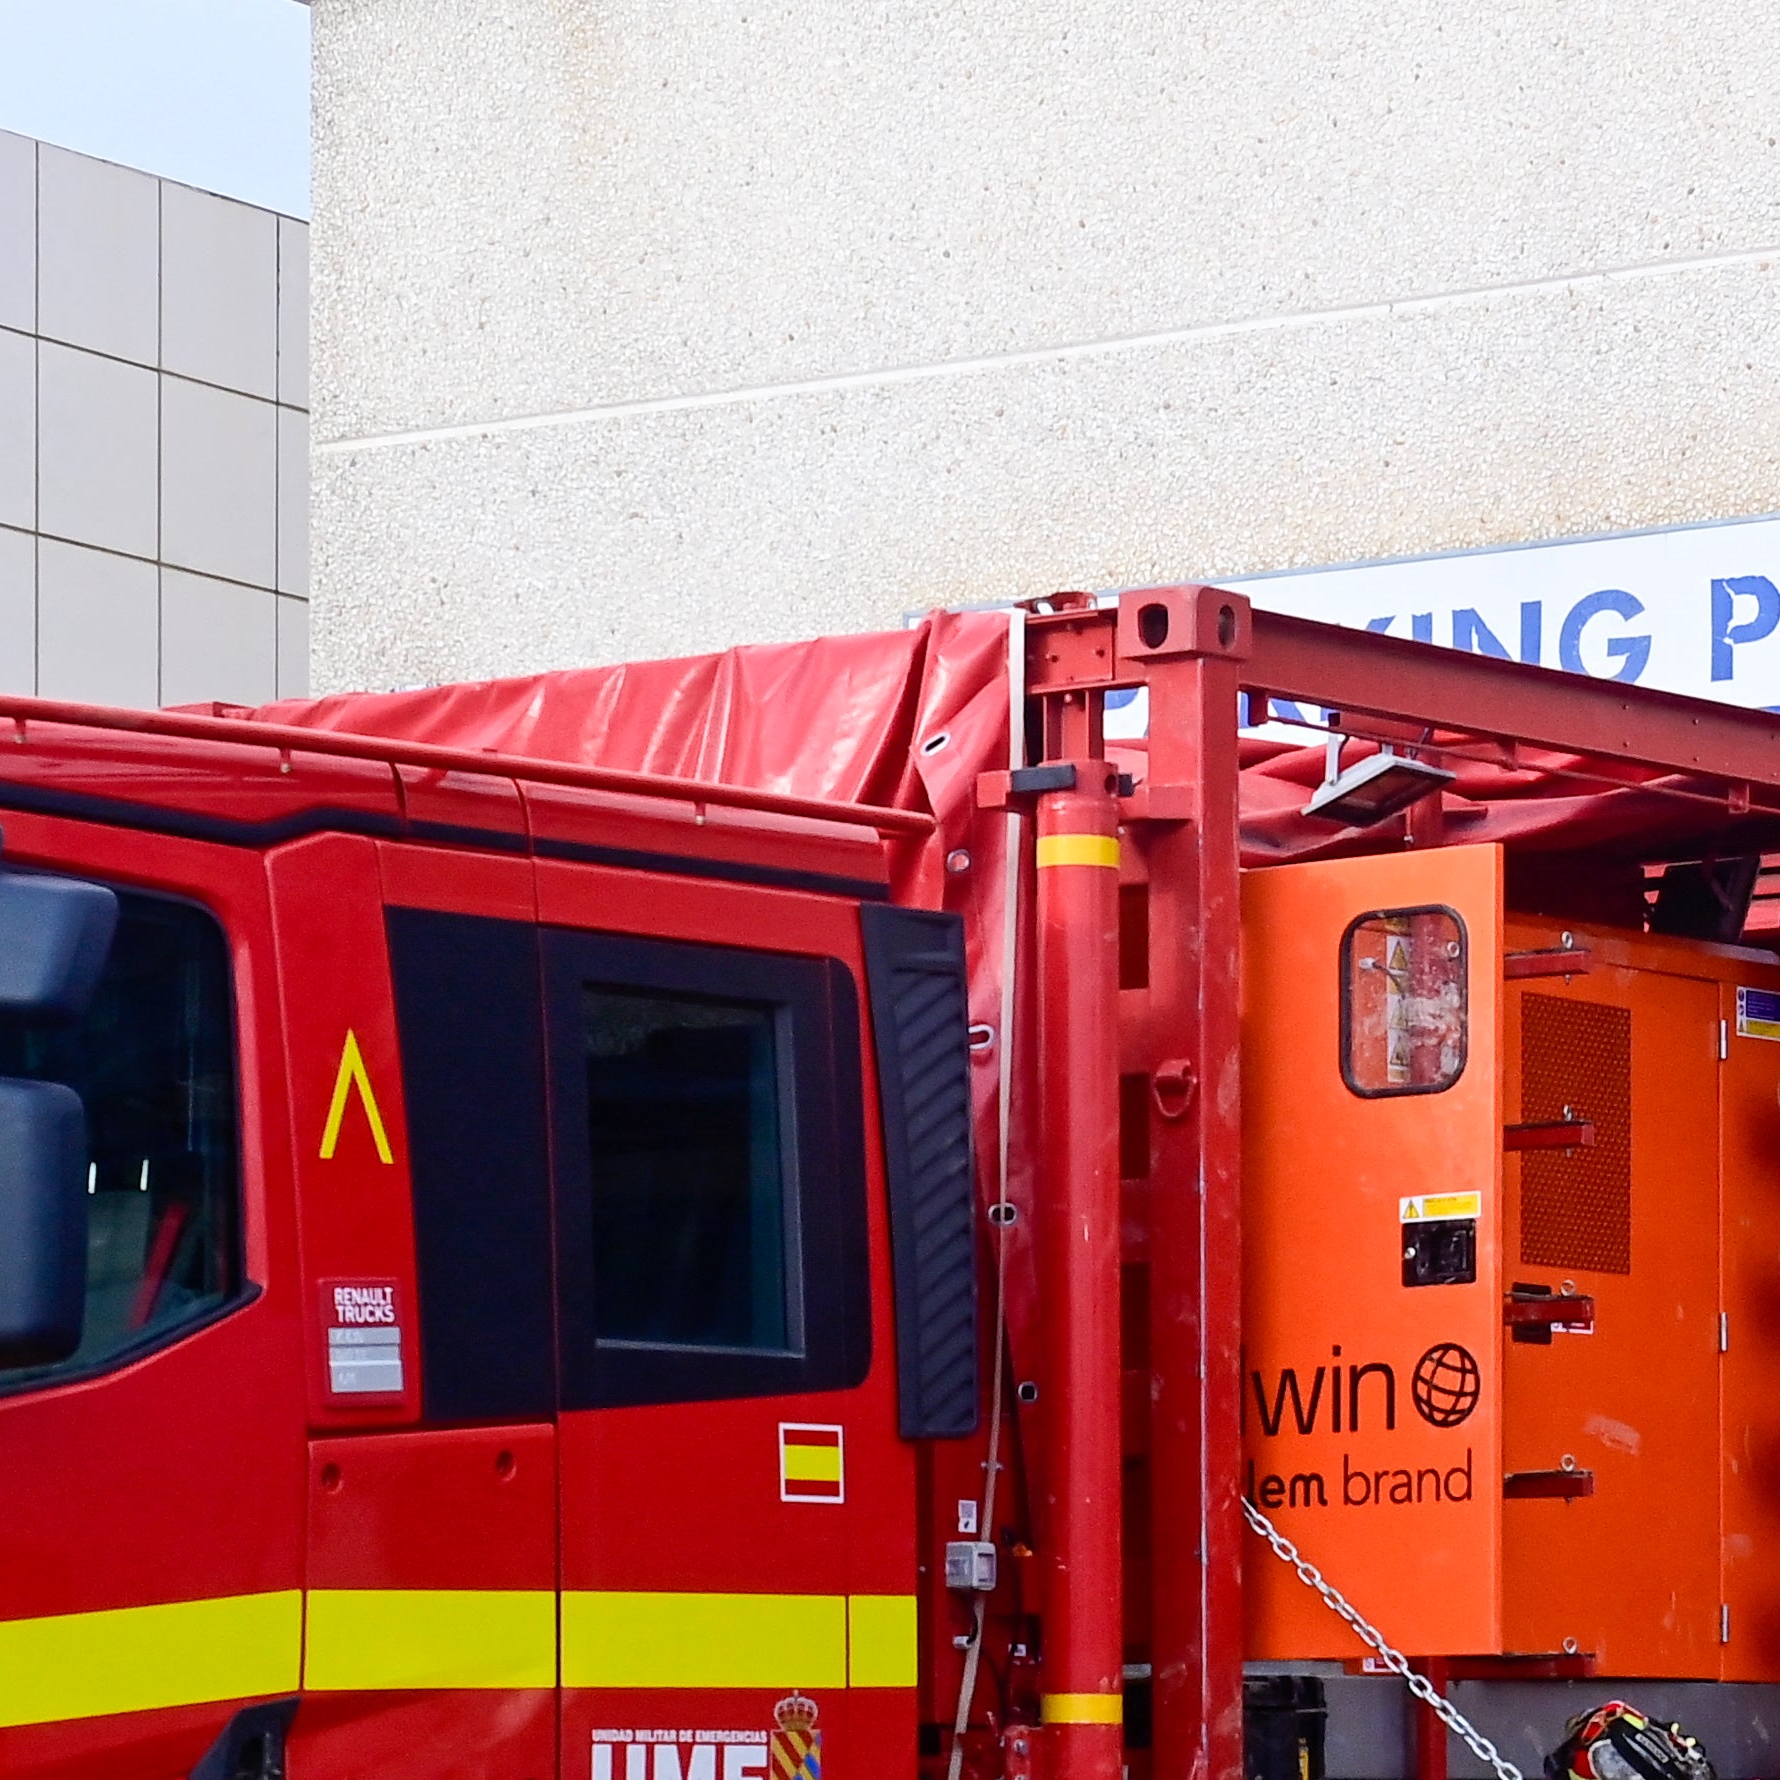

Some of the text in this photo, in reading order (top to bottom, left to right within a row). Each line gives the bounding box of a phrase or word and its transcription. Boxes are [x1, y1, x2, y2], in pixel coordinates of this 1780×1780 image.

[334, 1287, 393, 1305] RENAULT
[335, 1305, 395, 1323] TRUCKS
[1241, 1345, 1394, 1436] win
[1247, 1447, 1472, 1509] lem brand
[679, 1729, 694, 1742] DE
